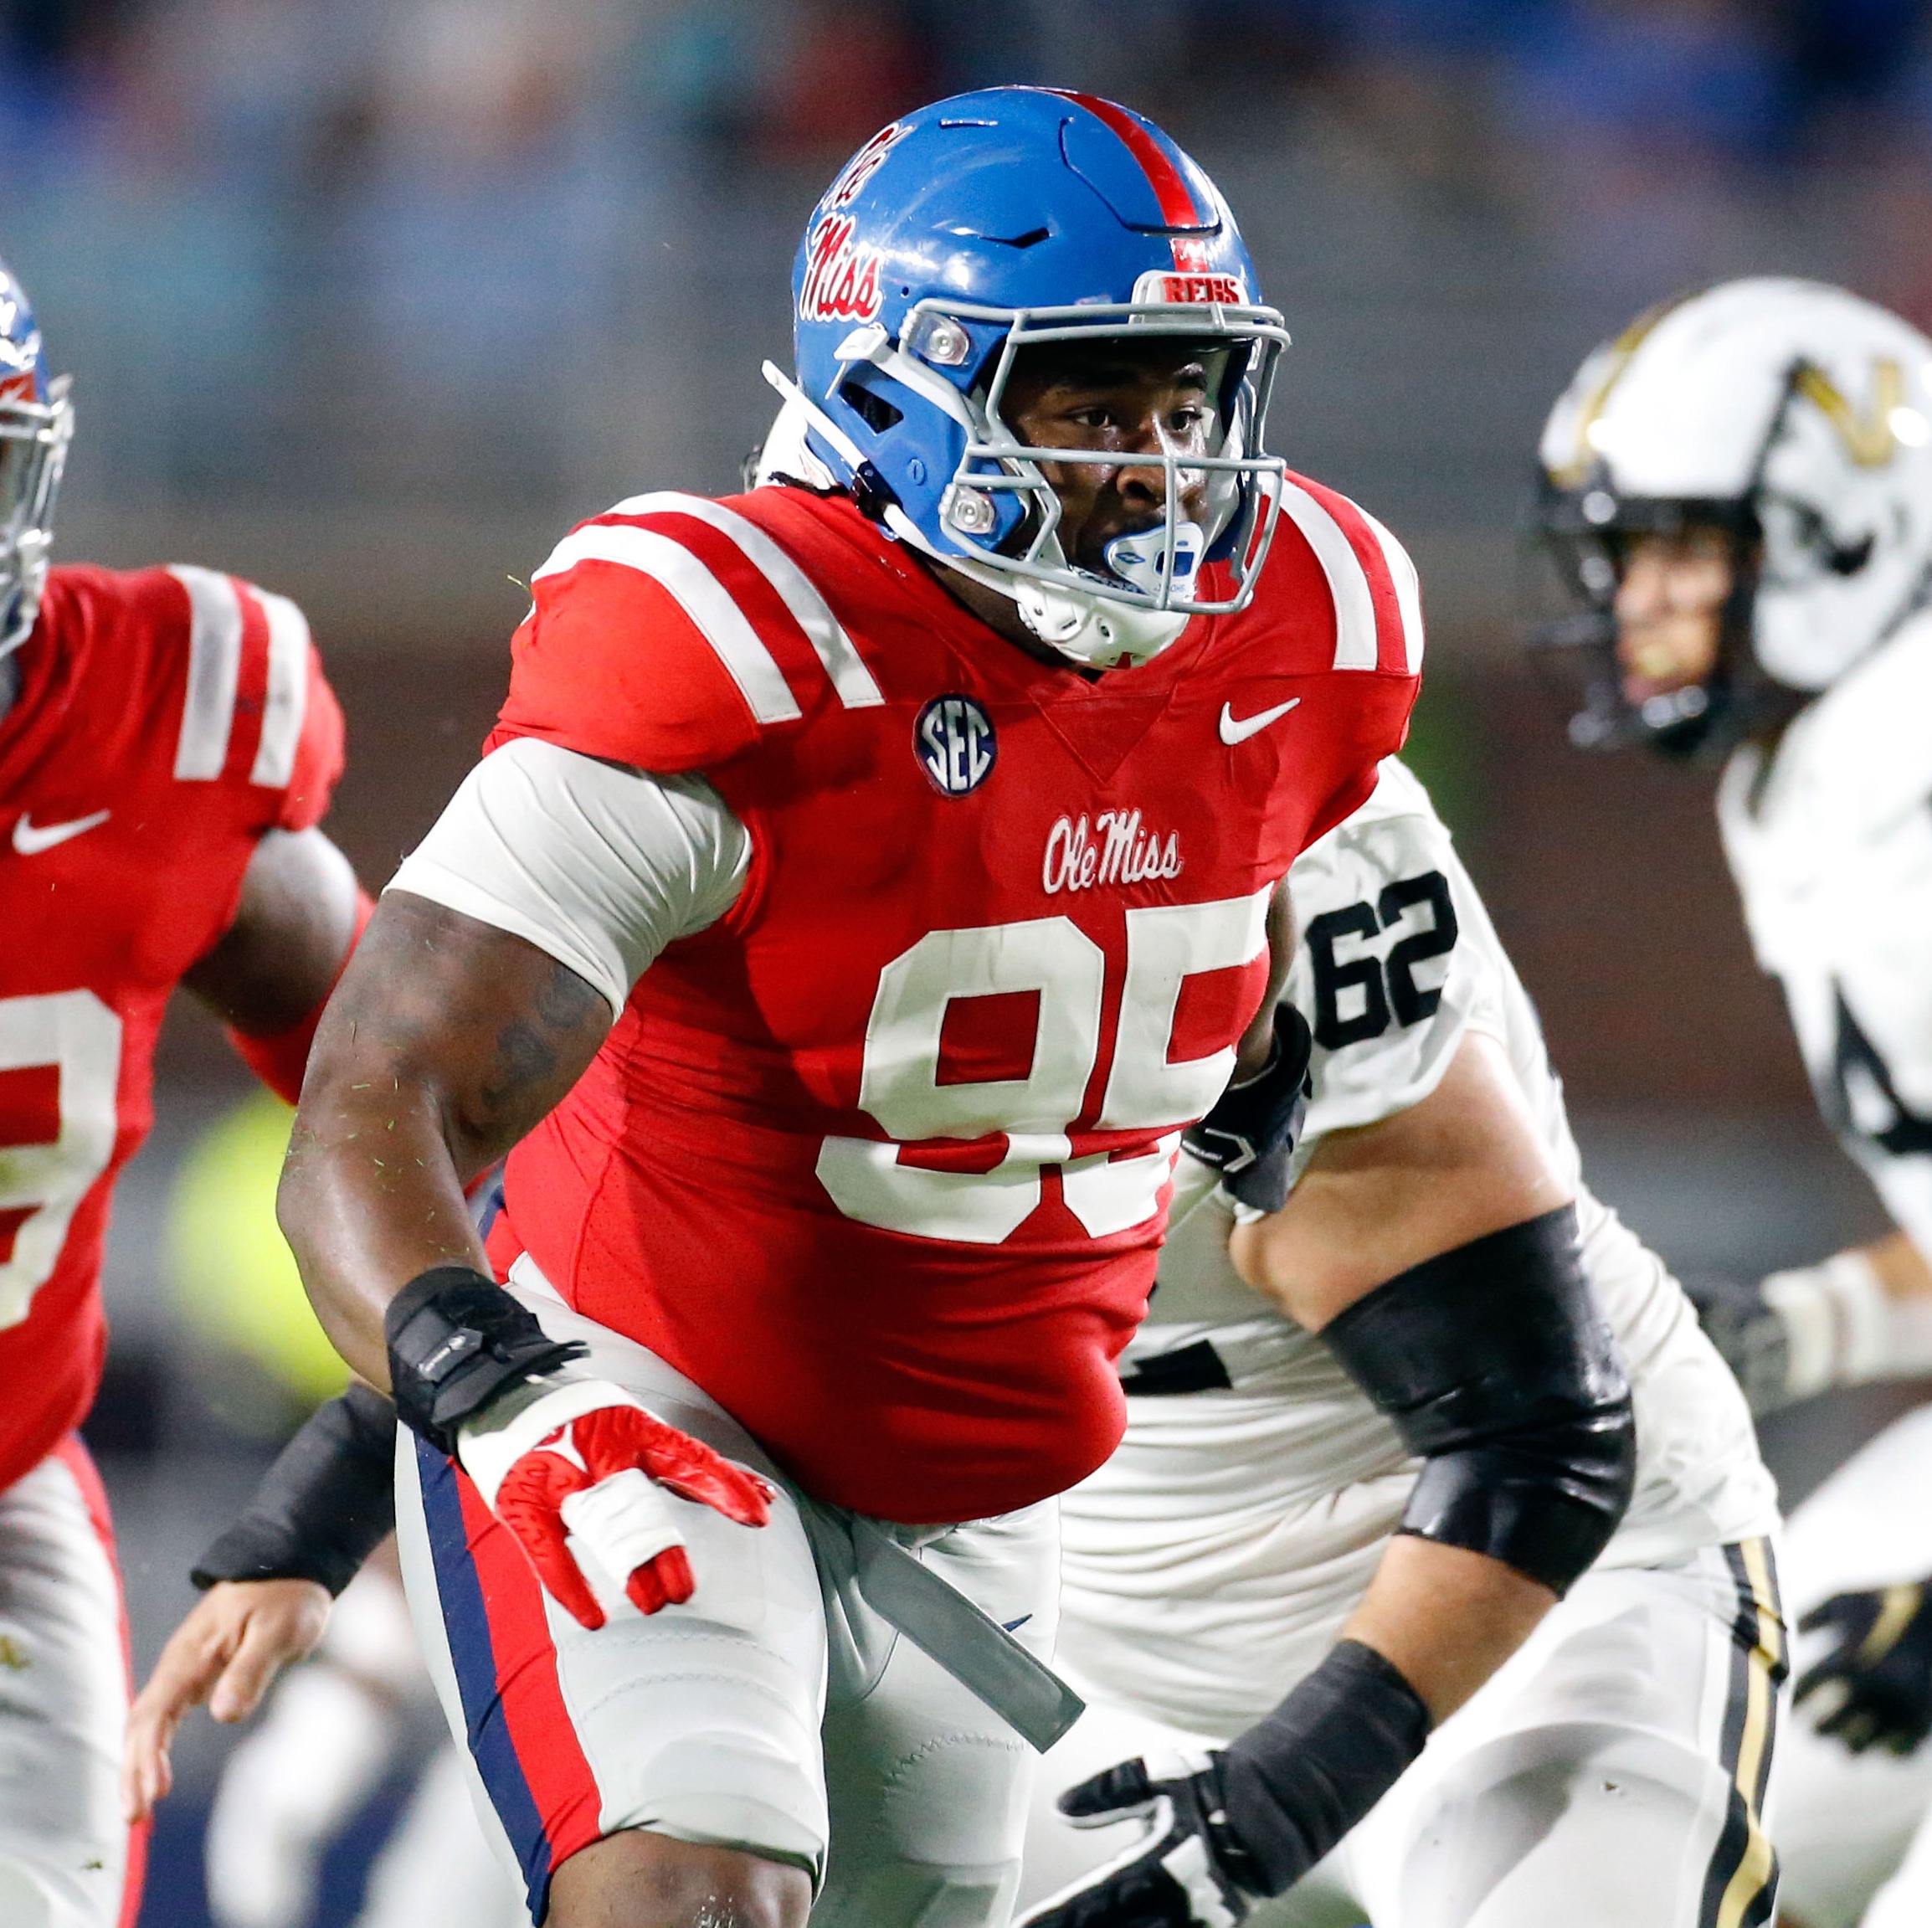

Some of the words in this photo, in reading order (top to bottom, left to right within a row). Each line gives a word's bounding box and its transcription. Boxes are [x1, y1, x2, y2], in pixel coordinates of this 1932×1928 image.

[799, 212, 884, 323] Miss
[1162, 276, 1240, 304] REBS
[922, 700, 991, 791] SEC
[1043, 814, 1096, 894] Ole
[1097, 808, 1183, 885] Miss
[1305, 870, 1458, 1051] 62
[814, 880, 1276, 1245] 95
